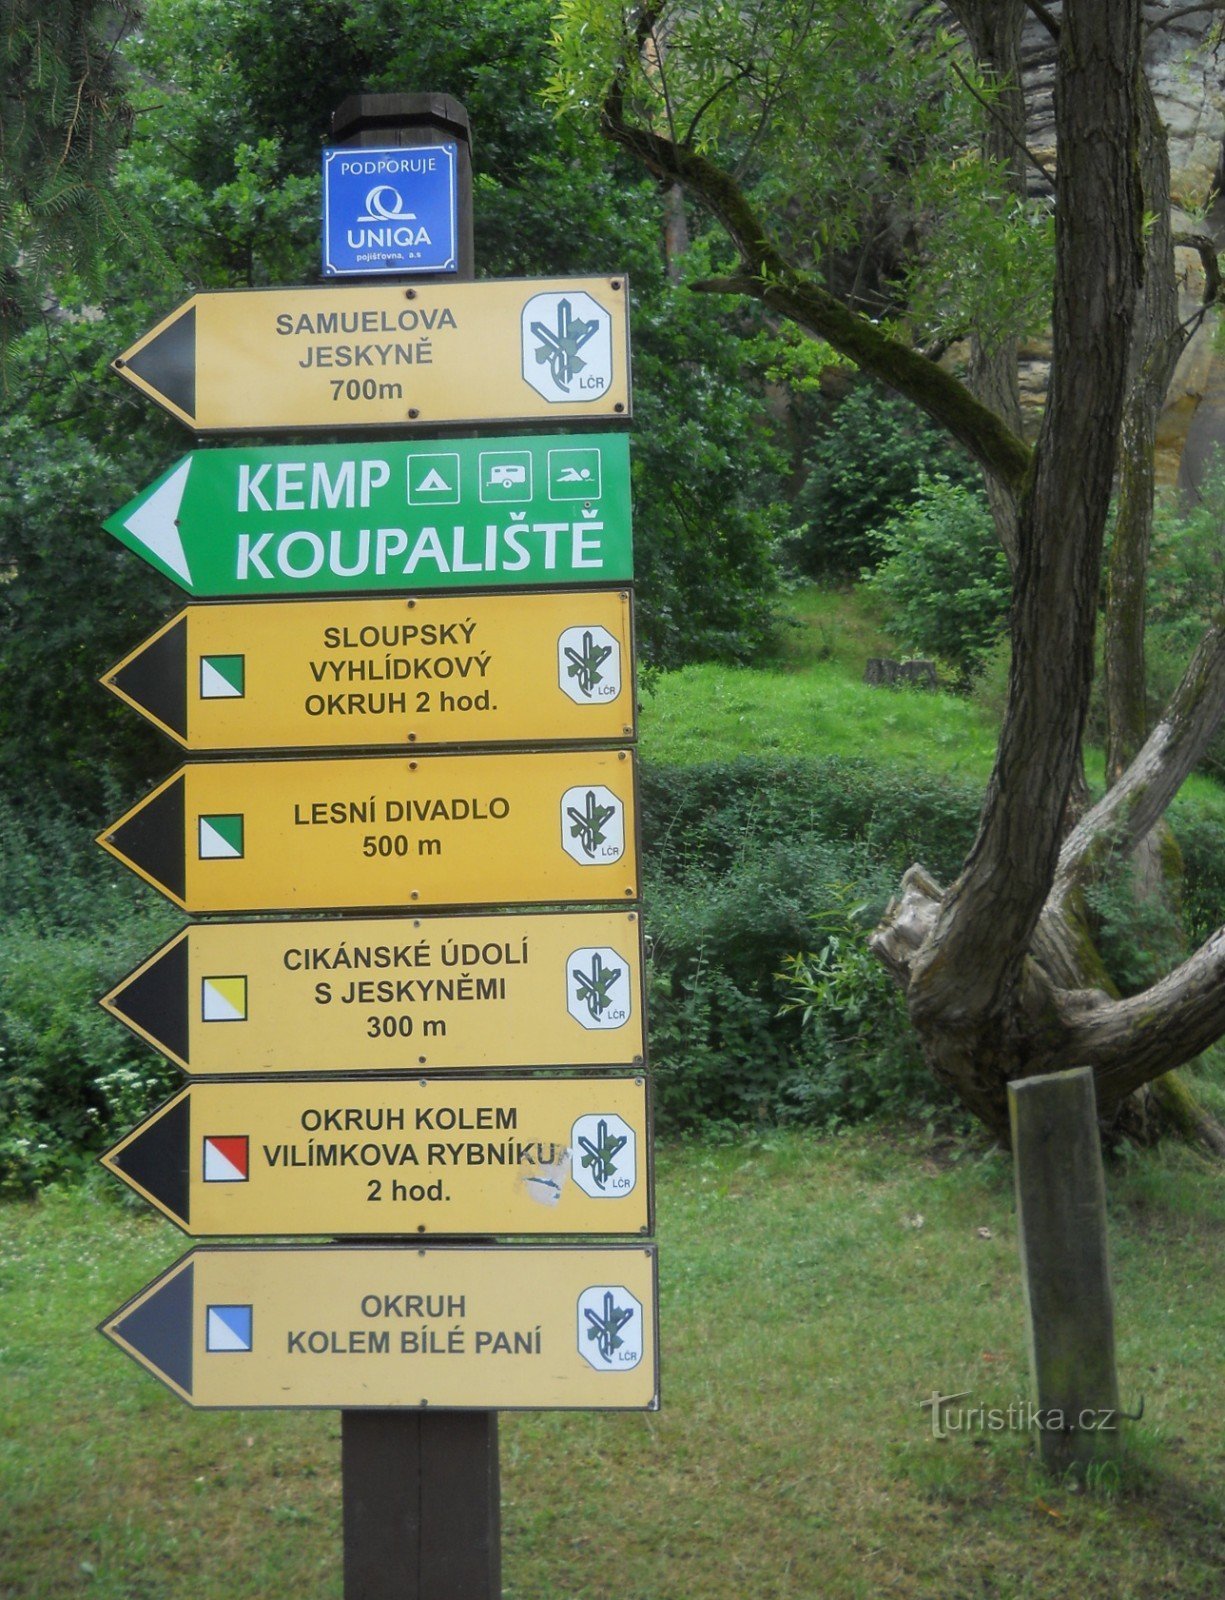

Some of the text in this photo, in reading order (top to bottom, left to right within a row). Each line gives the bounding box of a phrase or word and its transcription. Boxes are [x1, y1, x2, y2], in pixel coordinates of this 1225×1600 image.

[341, 158, 437, 176] PODPORUJE
[347, 227, 432, 249] UNIQA
[277, 308, 457, 336] SAMUELOVA
[299, 337, 433, 369] JESKYNĚ
[329, 378, 403, 402] 700m
[579, 374, 605, 389] LČR
[237, 460, 391, 512] KEMP
[236, 509, 604, 580] KOUPALIŠTĚ
[323, 617, 478, 648] SLOUPSKÝ
[309, 650, 492, 682] VYHLÍDKOVÝ
[598, 684, 617, 696] LČR
[304, 690, 499, 716] OKRUH 2 hod.
[294, 796, 511, 825] LESNÍ DIVADLO
[362, 835, 442, 857] 500 m
[601, 845, 620, 856] LČR
[283, 936, 529, 970] CIKÁNSKÉ ÚDOLÍ
[314, 972, 507, 1005] S JESKYNĚMI
[366, 1016, 447, 1038] 300 m
[607, 1009, 626, 1021] LČR
[300, 1107, 518, 1131] OKRUH KOLEM
[263, 1137, 556, 1167] VILÍMKOVA RYBNÍKU
[367, 1178, 451, 1202] 2 hod.
[612, 1178, 631, 1189] LČR
[361, 1295, 466, 1318] OKRUH
[288, 1325, 542, 1354] KOLEM BÍLÉ PANÍ
[618, 1350, 638, 1363] LČR
